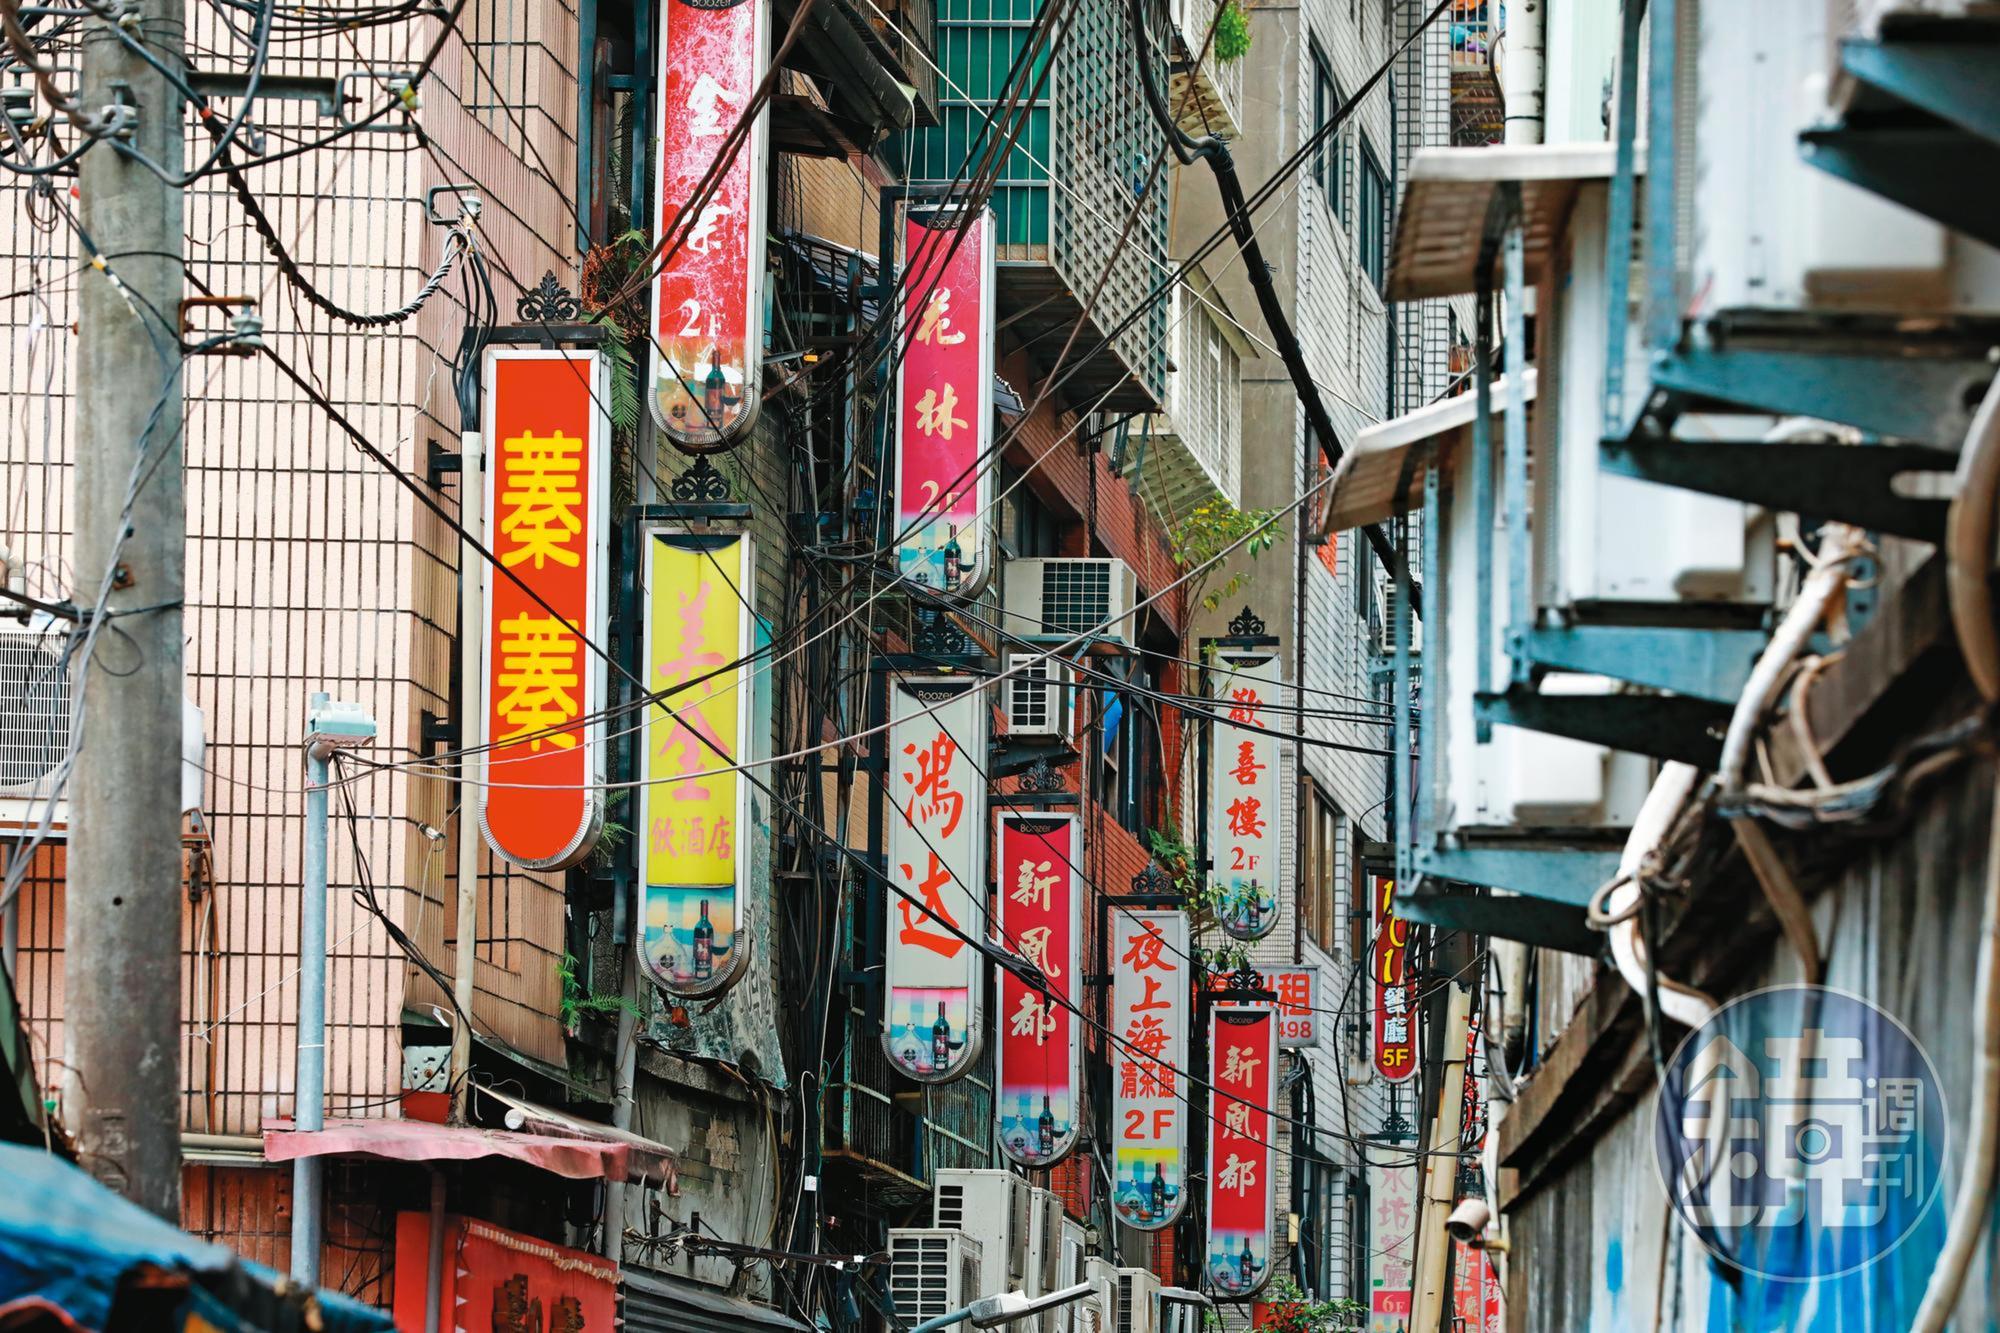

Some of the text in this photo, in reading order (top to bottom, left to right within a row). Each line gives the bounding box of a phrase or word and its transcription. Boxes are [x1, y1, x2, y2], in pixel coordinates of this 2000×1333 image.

[915, 287, 967, 514] 花林 2F
[497, 430, 582, 752] 蓁蓁
[658, 581, 731, 801] 美金
[653, 816, 731, 860] 飲酒店
[1230, 846, 1260, 871] 2F
[1122, 921, 1178, 1058] 夜上海
[1382, 1049, 1409, 1067] 5F
[1120, 1060, 1176, 1099] 清茶館
[1123, 1109, 1176, 1140] 2F
[1381, 1294, 1406, 1313] 6F
